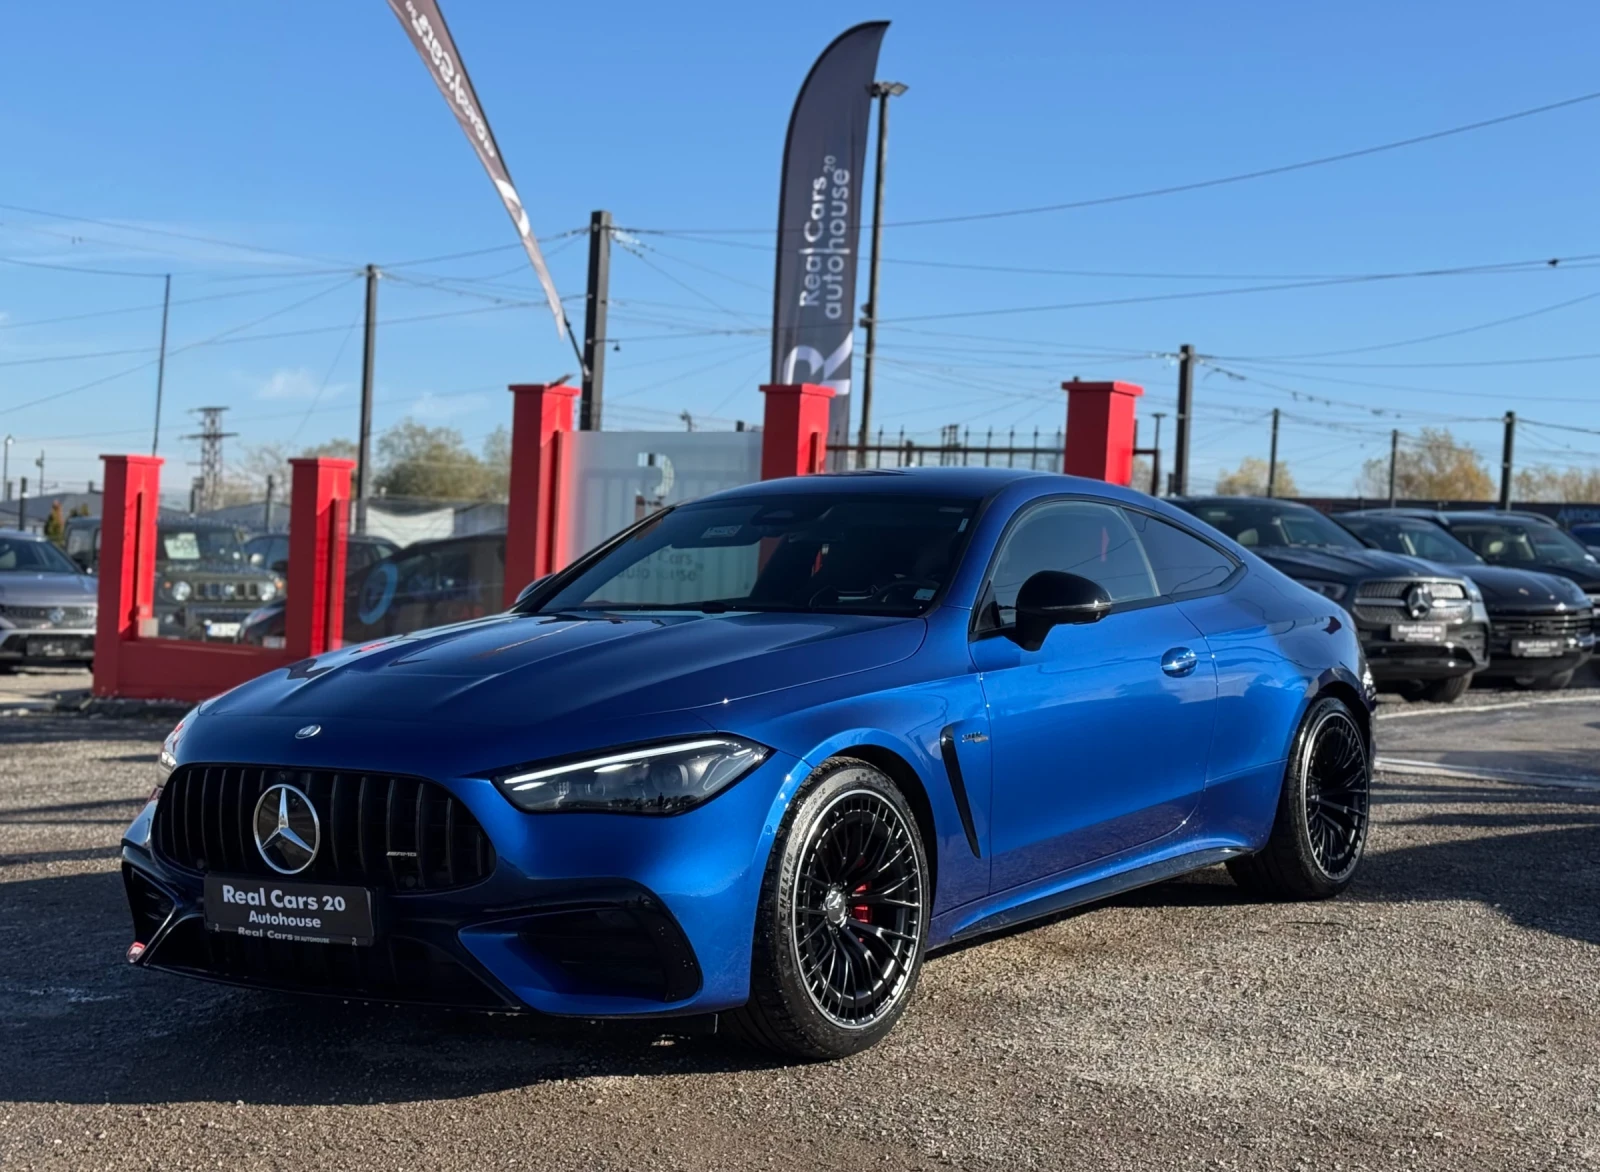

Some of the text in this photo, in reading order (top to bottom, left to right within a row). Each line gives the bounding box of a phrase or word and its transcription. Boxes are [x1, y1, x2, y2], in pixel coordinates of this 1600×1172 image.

[799, 155, 837, 306] Real Cars 20
[825, 168, 850, 319] autohouse
[222, 884, 346, 912] Real Cars 20
[248, 910, 322, 928] Autohouse
[779, 852, 794, 945] MICHELIN
[238, 926, 263, 938] Real
[267, 930, 293, 941] Cars
